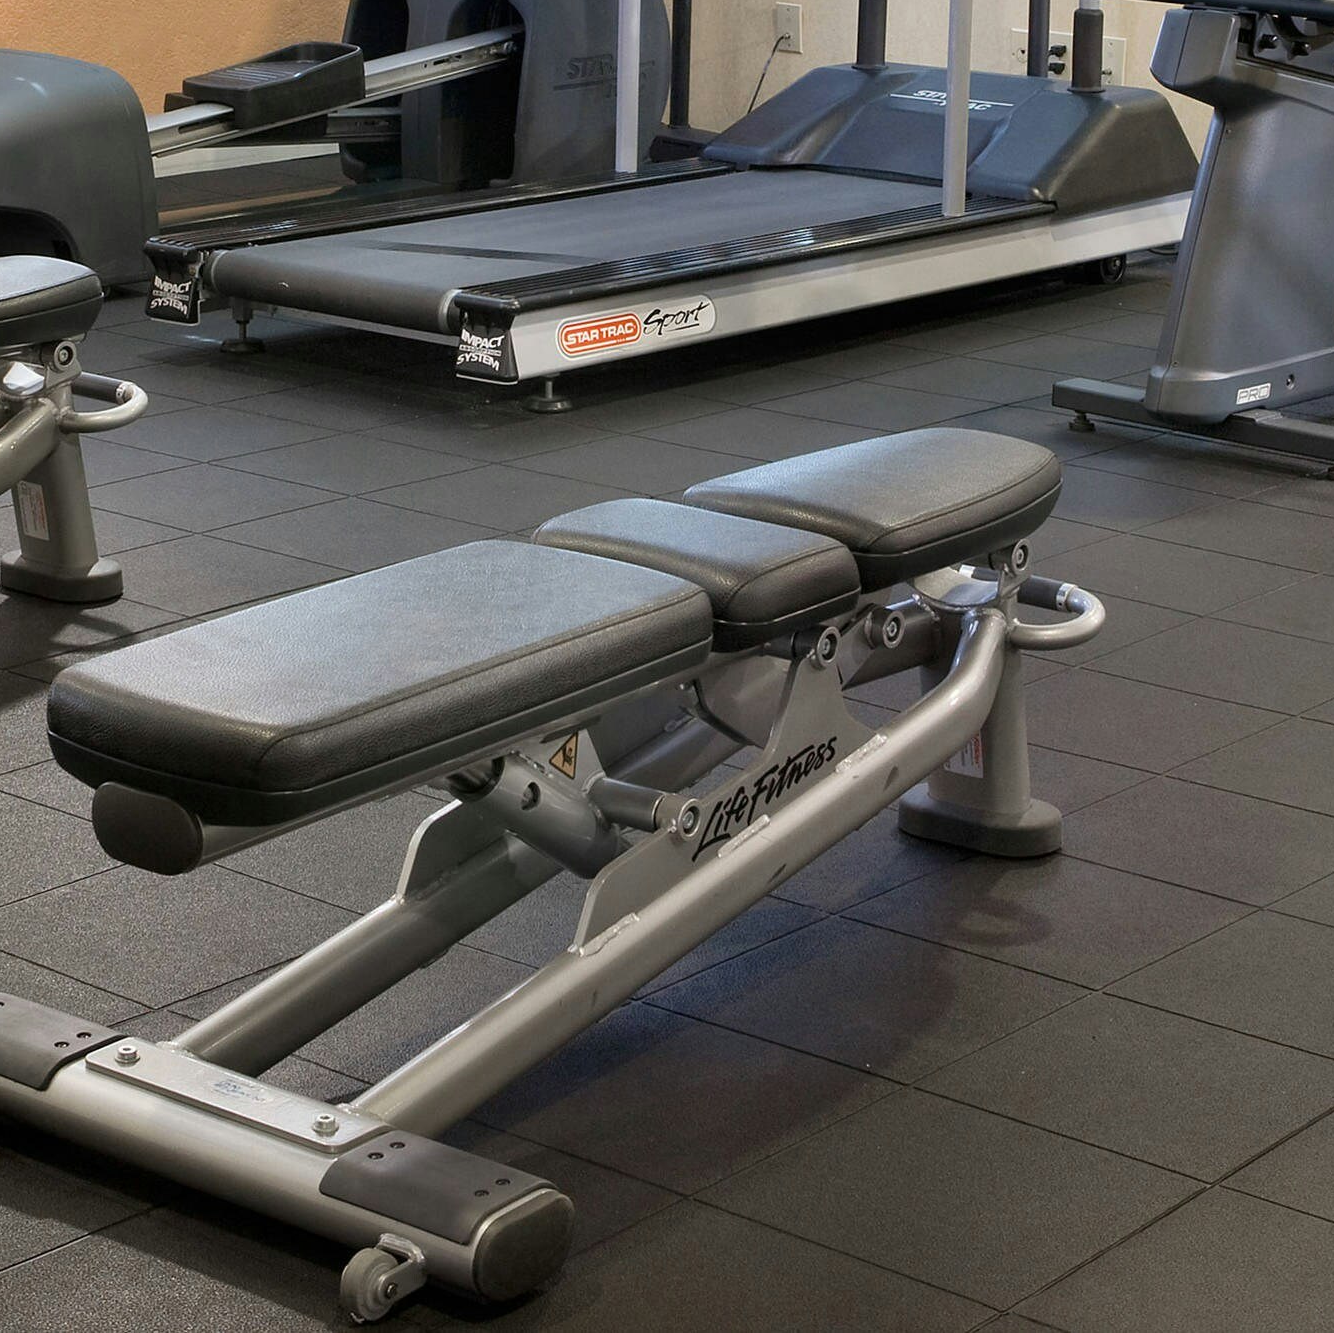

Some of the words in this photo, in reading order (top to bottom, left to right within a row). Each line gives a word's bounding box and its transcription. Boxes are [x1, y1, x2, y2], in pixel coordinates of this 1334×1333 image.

[154, 275, 192, 294] IMPACT
[150, 297, 188, 315] SYSTEM
[565, 328, 600, 345] STAR
[600, 322, 636, 339] TRAC
[643, 301, 710, 336] Sport
[461, 328, 505, 349] IMPACT
[456, 352, 500, 372] SYSTEM
[691, 786, 750, 863] Life
[747, 735, 838, 827] Fitness
